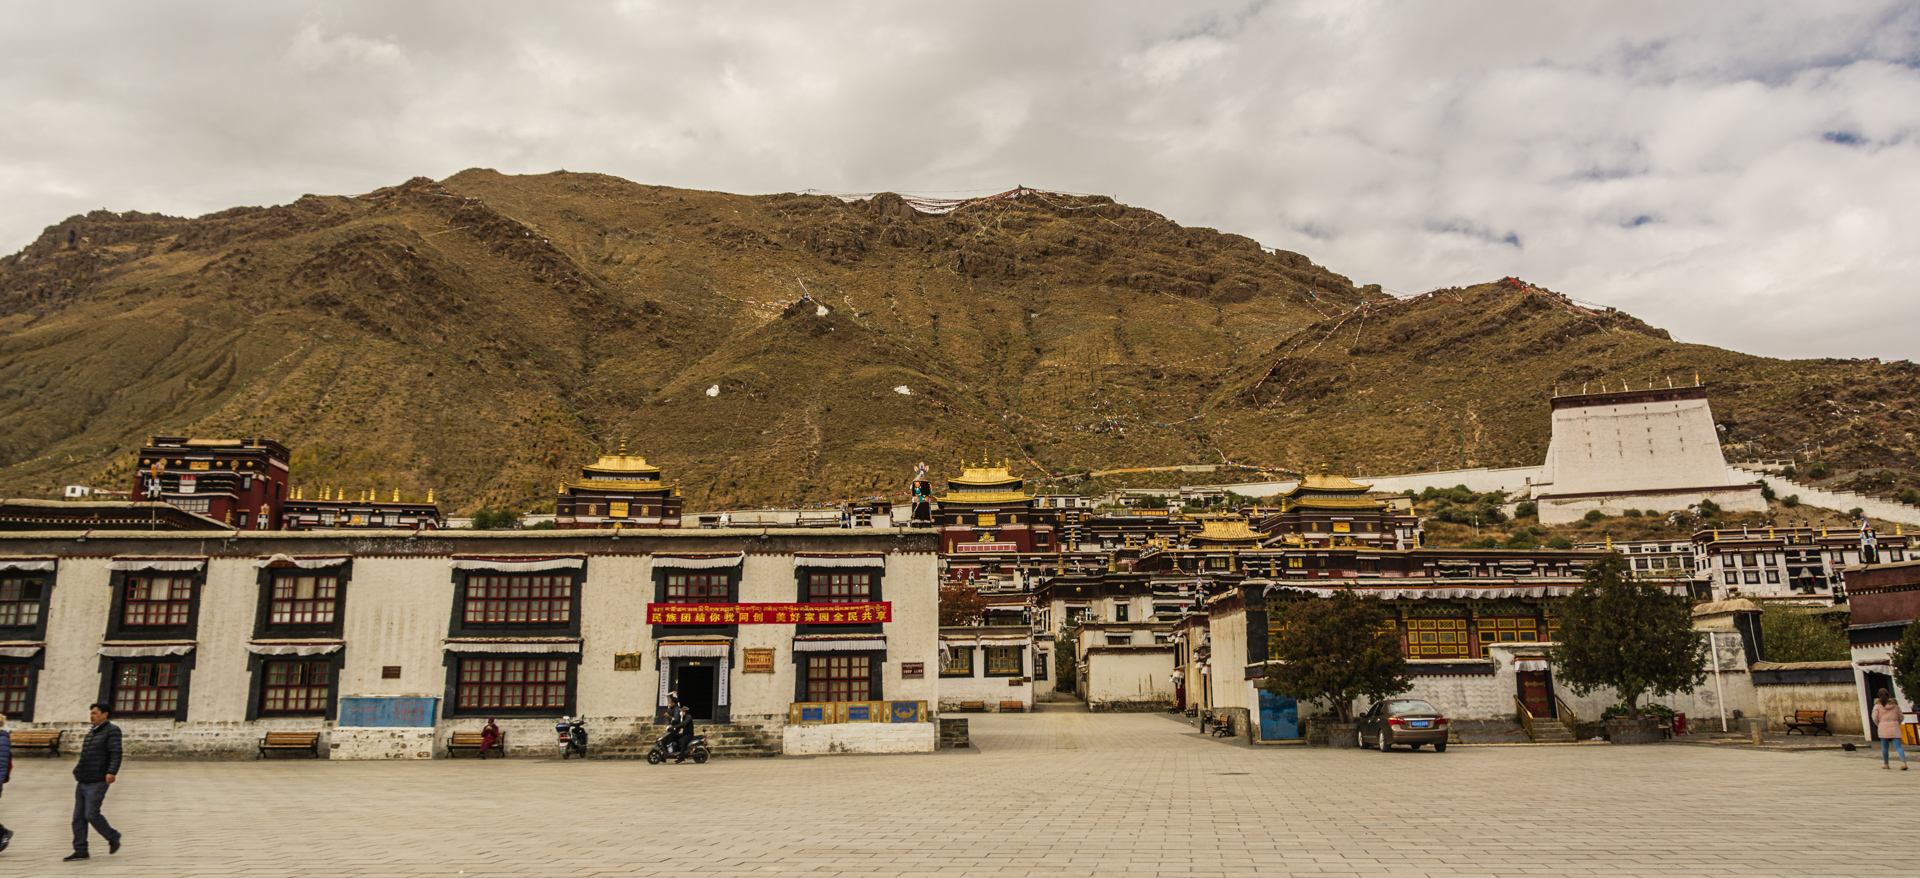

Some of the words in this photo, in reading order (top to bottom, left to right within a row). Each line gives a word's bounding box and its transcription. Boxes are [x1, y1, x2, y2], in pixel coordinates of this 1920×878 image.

[652, 612, 764, 623] 民族团结你我同创
[775, 611, 887, 623] 美好家园全民共享
